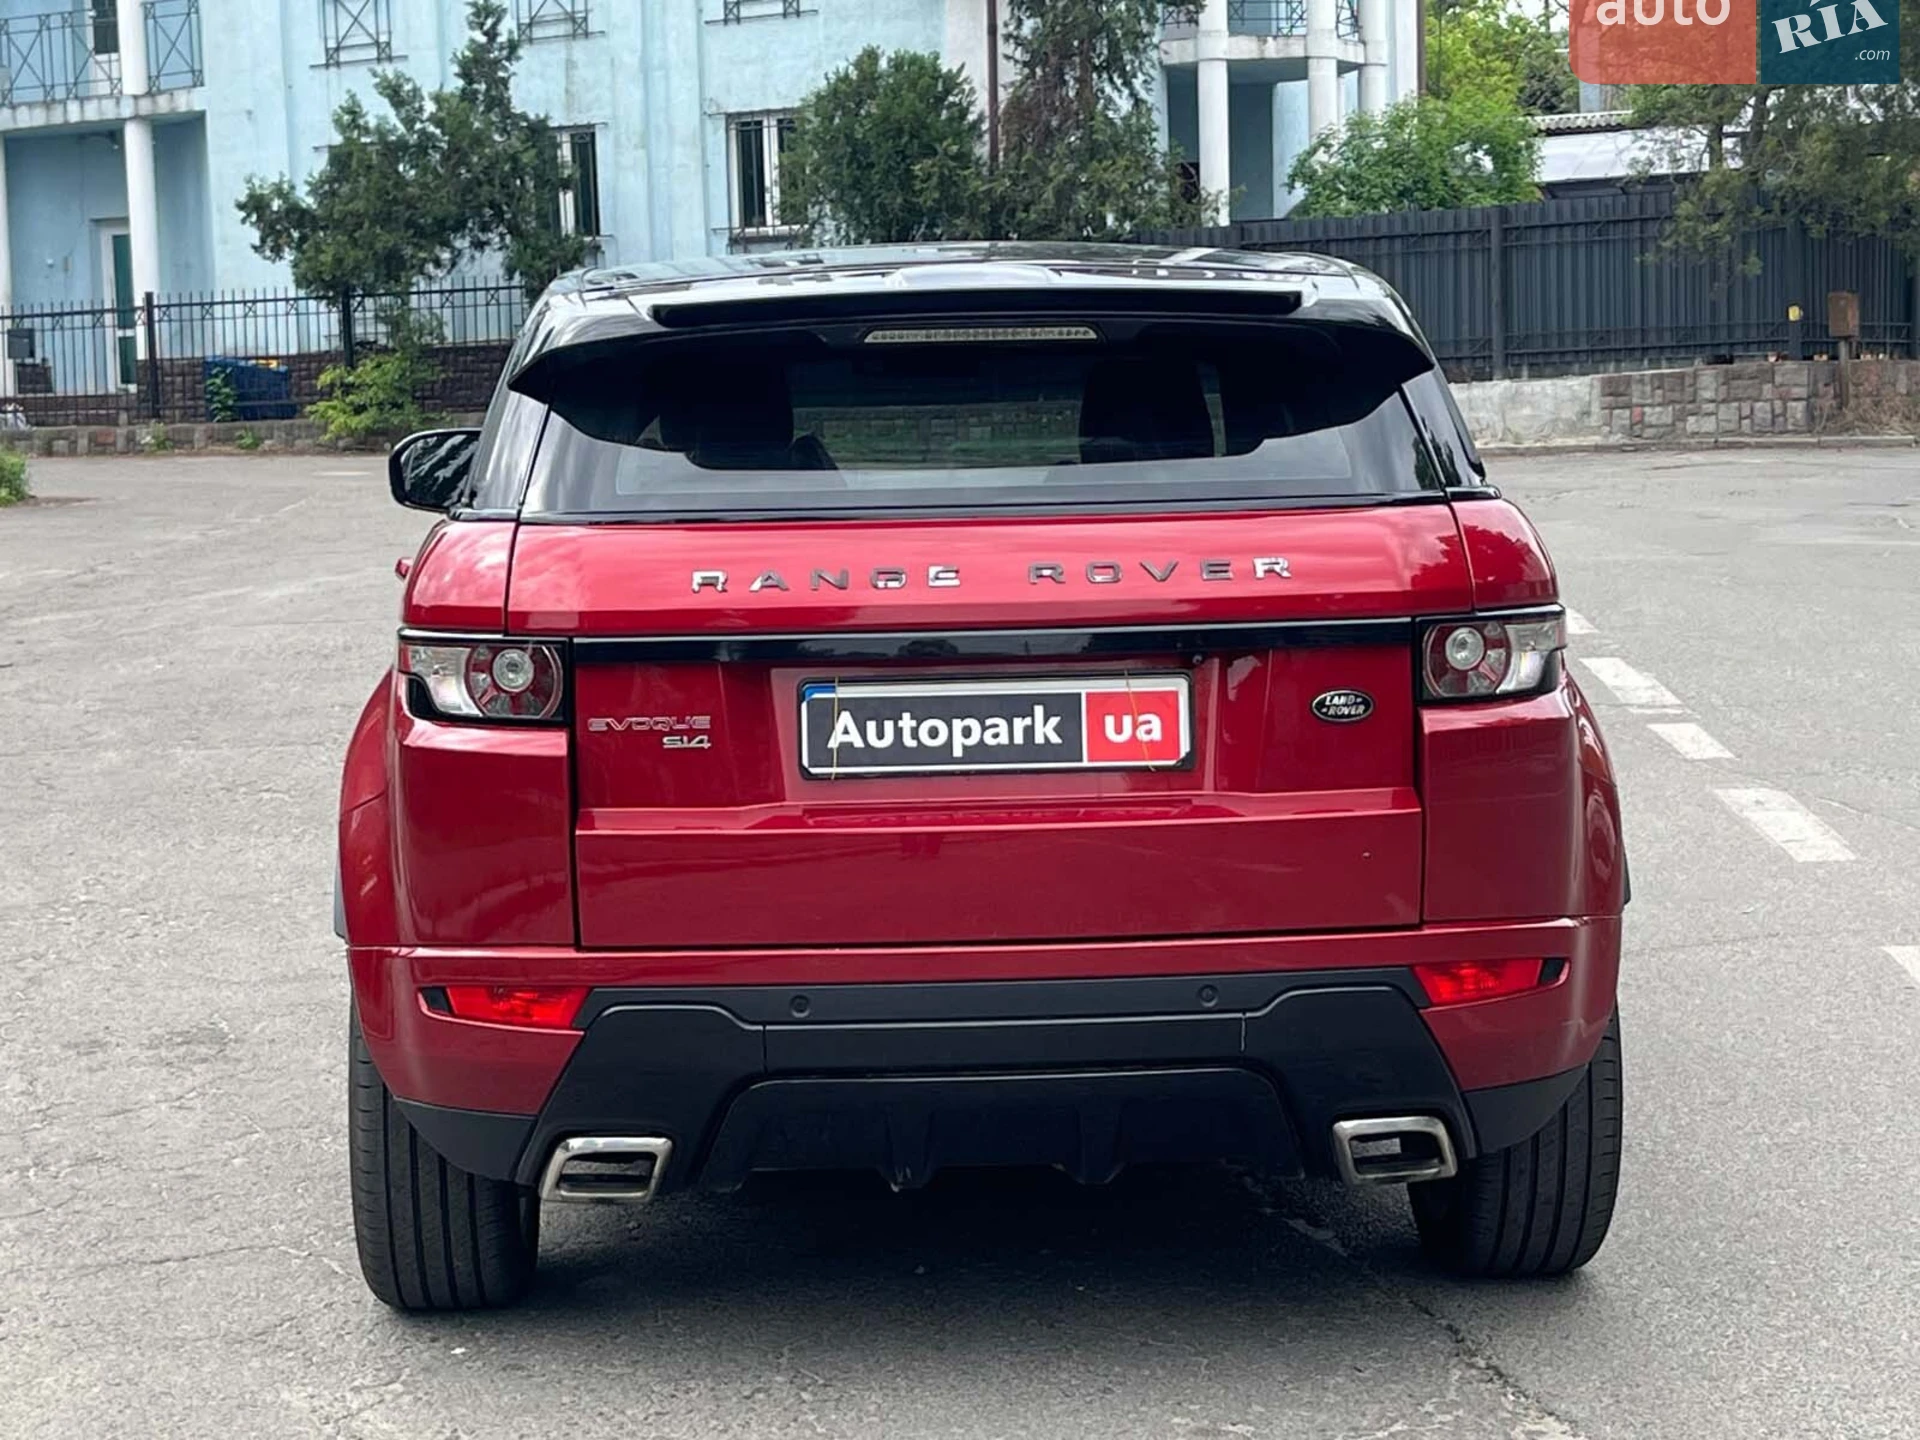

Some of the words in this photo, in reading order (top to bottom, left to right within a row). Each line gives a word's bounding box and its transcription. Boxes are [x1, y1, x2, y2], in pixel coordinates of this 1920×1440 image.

[691, 564, 961, 594] RANGE
[1028, 556, 1292, 585] ROVER
[587, 715, 711, 732] EVOQUE
[827, 704, 1063, 758] Autopark
[1104, 712, 1163, 745] ua
